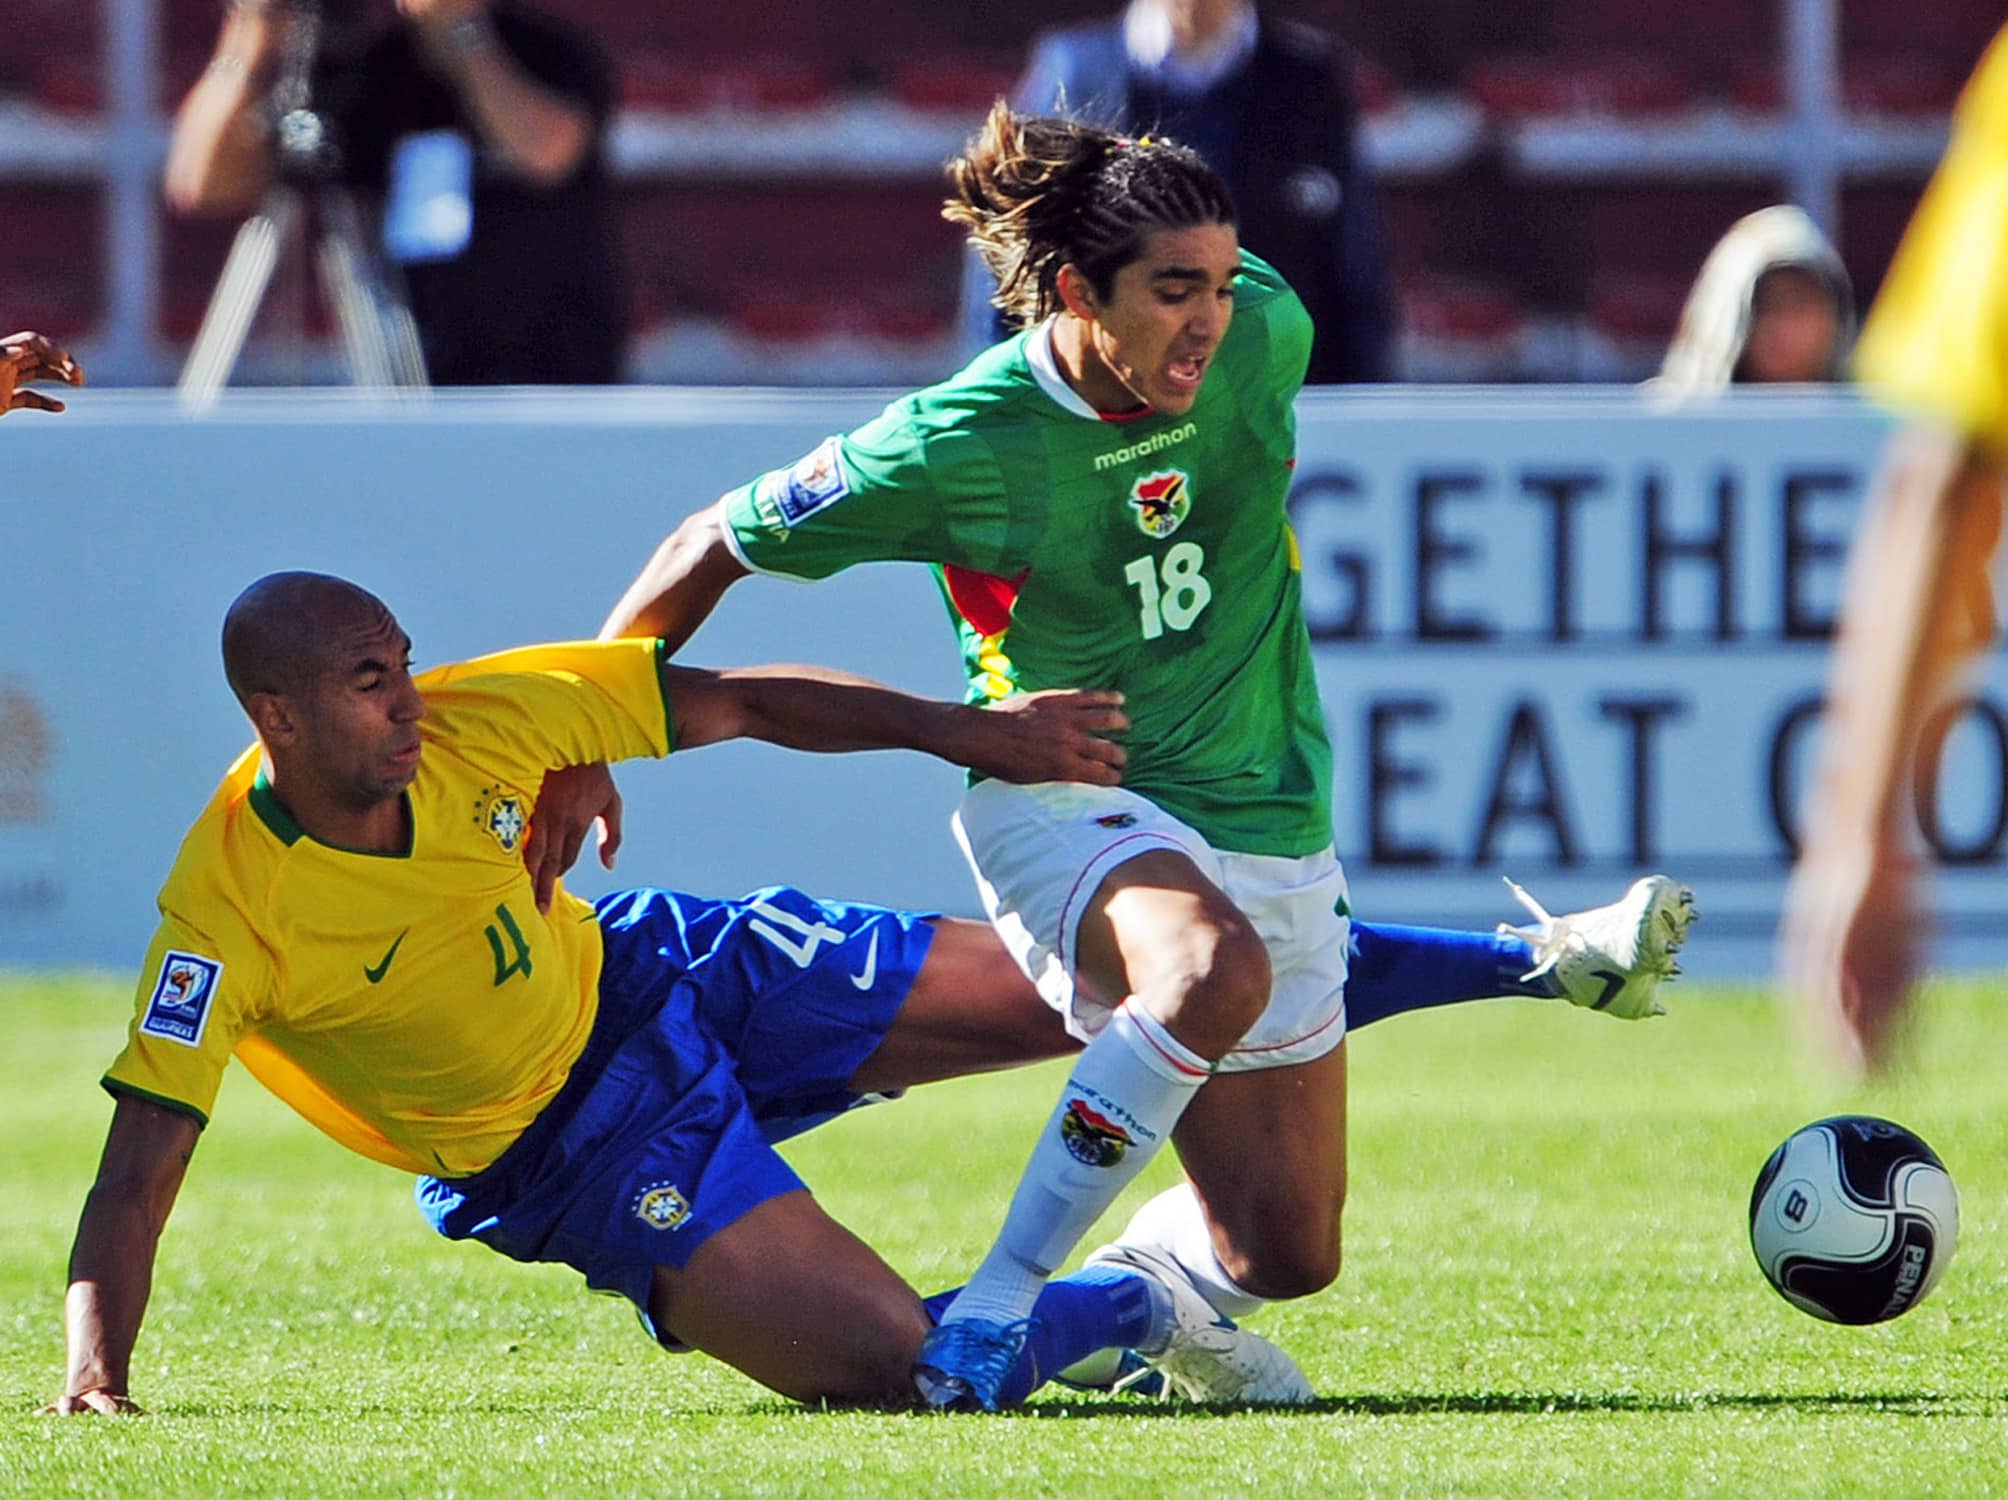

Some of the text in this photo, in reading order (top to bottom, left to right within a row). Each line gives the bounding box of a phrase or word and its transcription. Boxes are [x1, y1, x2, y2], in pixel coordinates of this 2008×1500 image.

[1094, 422, 1197, 470] marathon
[1124, 541, 1212, 641] 18
[483, 903, 533, 987] 4
[748, 901, 847, 968] 4
